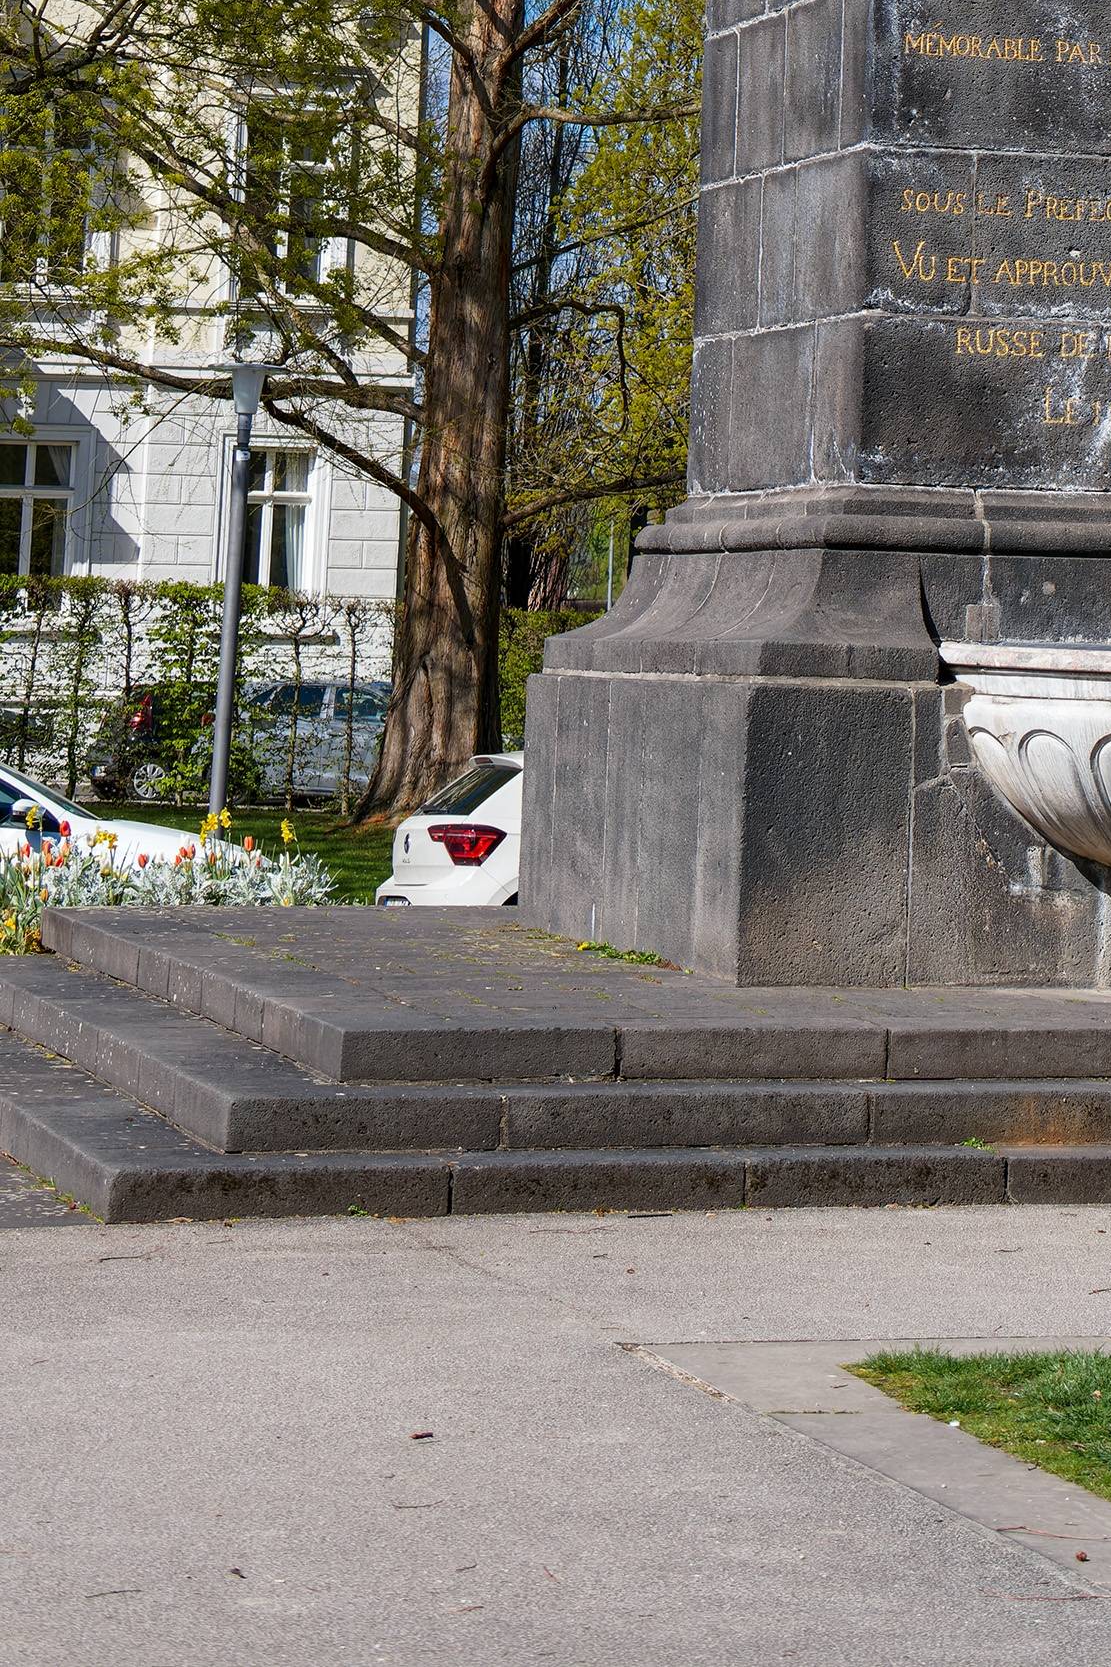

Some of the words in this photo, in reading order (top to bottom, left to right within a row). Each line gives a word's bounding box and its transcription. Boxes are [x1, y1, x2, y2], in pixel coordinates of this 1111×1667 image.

[904, 21, 1043, 61] MÉMORABLE
[1055, 40, 1101, 64] PAR
[900, 189, 966, 215] SOUS
[975, 193, 1011, 216] LE
[892, 239, 936, 281] VU
[946, 256, 986, 284] ET
[955, 328, 1045, 358] RUSSE
[1060, 333, 1096, 359] DE
